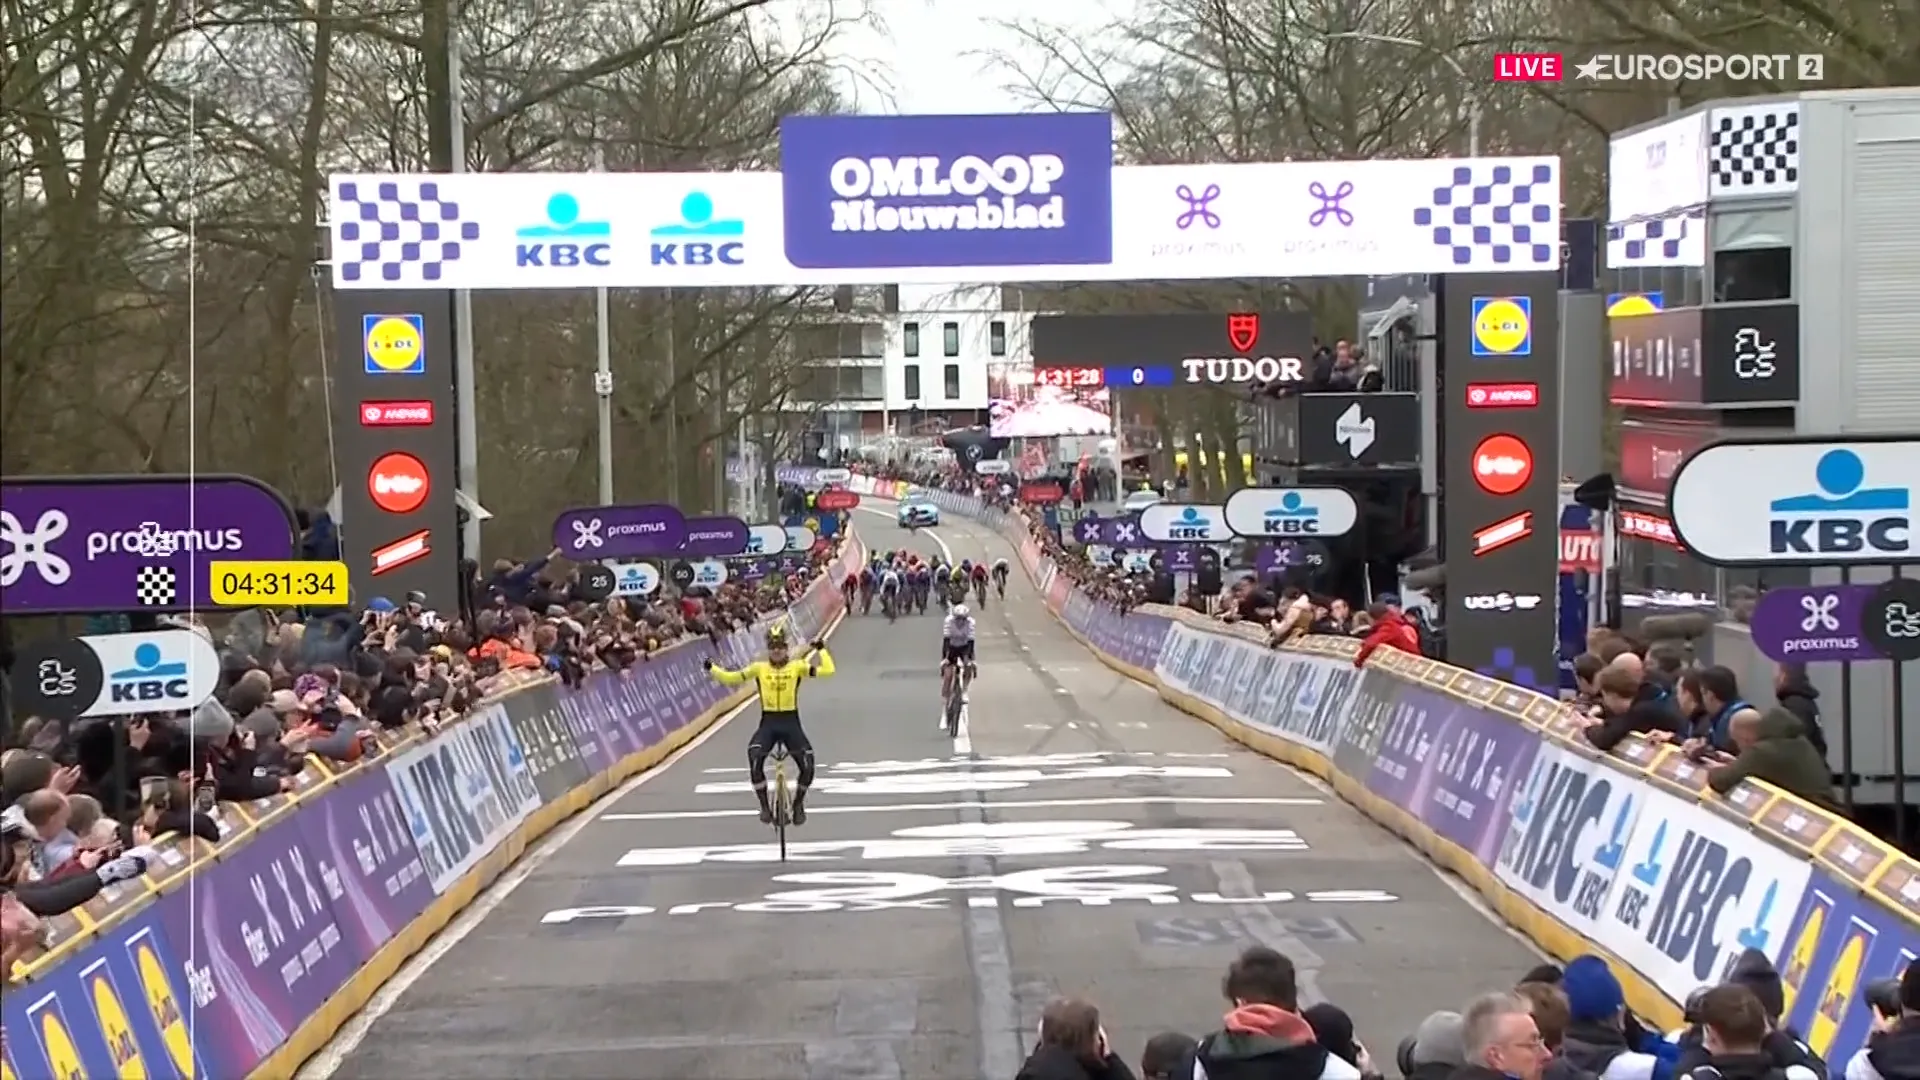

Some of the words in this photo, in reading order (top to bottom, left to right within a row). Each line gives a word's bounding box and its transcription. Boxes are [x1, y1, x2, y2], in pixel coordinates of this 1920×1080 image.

[830, 154, 1064, 197] OMLOOP
[830, 195, 1065, 231] Nieuwsblad
[516, 243, 611, 266] KBC
[650, 242, 745, 265] KBC
[1182, 358, 1304, 382] TUDOR
[607, 520, 666, 538] proximus
[688, 530, 734, 543] proximus
[1169, 528, 1210, 539] KBC
[1264, 519, 1319, 533] KBC
[1770, 517, 1910, 553] KBC
[591, 575, 608, 588] 25
[1783, 636, 1859, 656] proximus
[111, 679, 189, 702] KBC
[1513, 761, 1612, 904] KBC
[541, 889, 1400, 923] proximus
[1572, 871, 1610, 921] KBC
[1615, 883, 1654, 930] KBC
[1645, 829, 1753, 982] KBC
